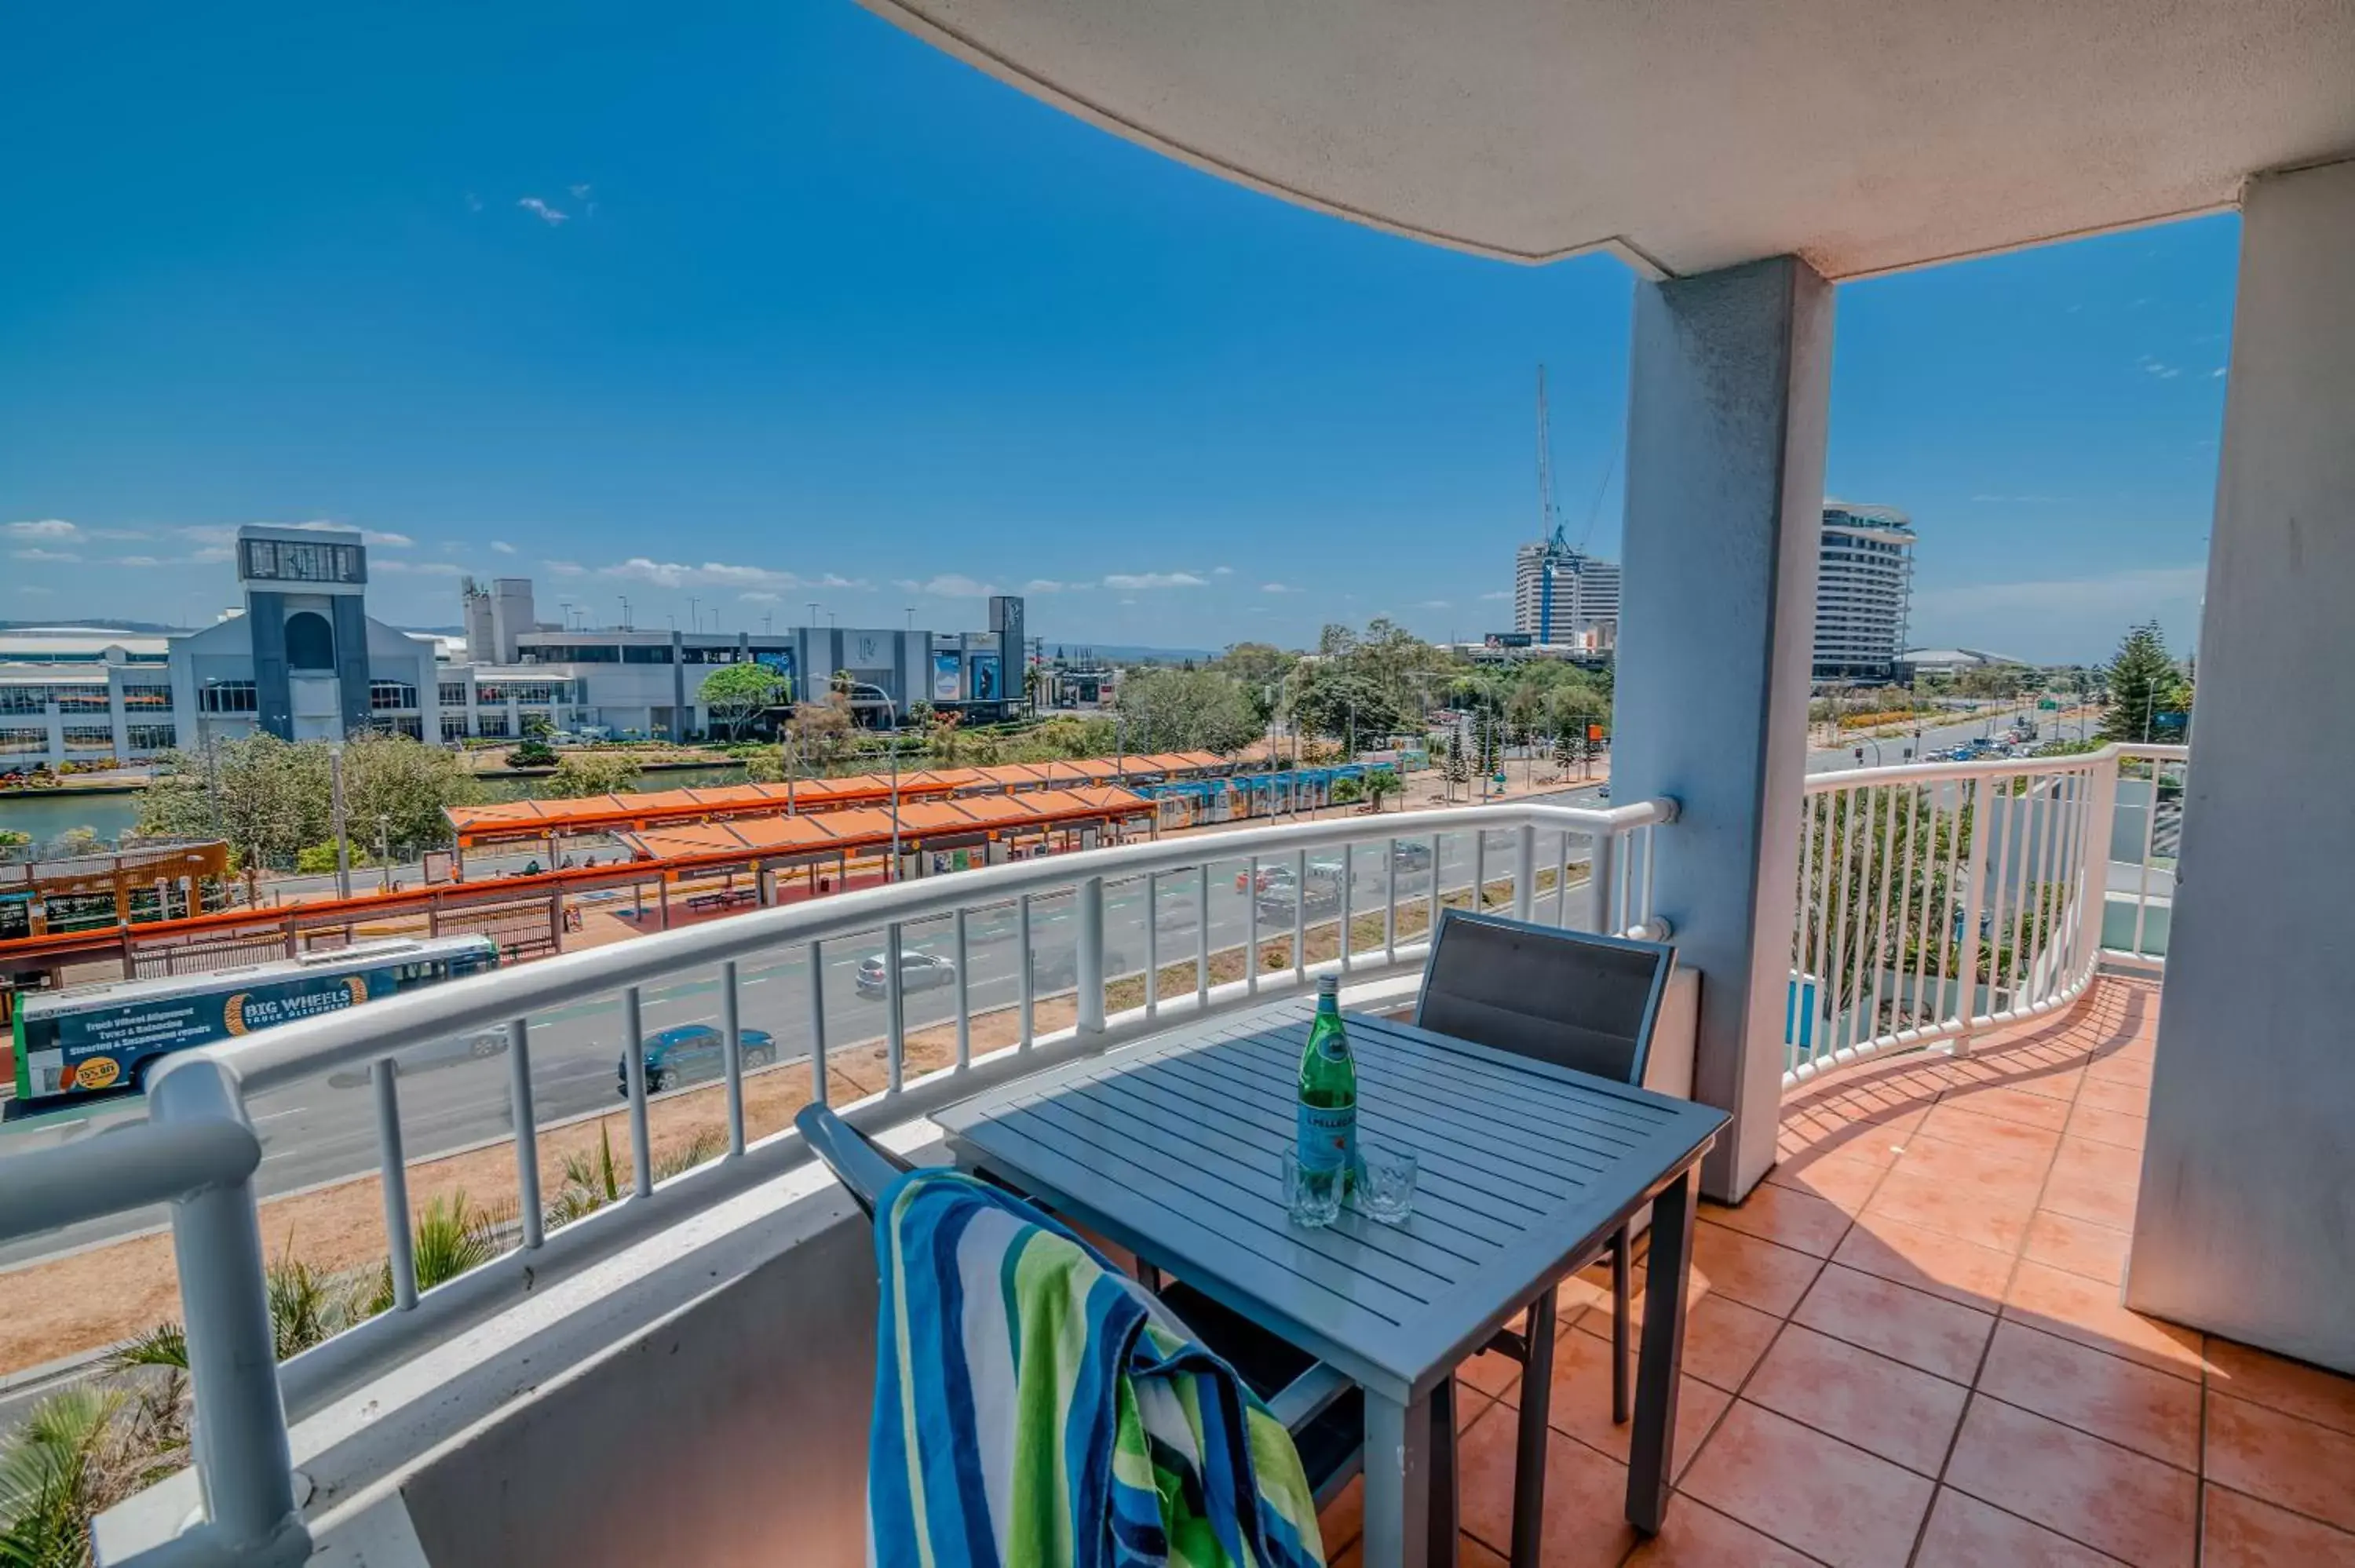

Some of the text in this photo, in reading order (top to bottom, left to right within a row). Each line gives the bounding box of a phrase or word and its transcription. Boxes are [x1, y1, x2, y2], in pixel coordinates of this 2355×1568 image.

[244, 989, 350, 1018] BIG WHEELS
[246, 1013, 283, 1024] TRUCK
